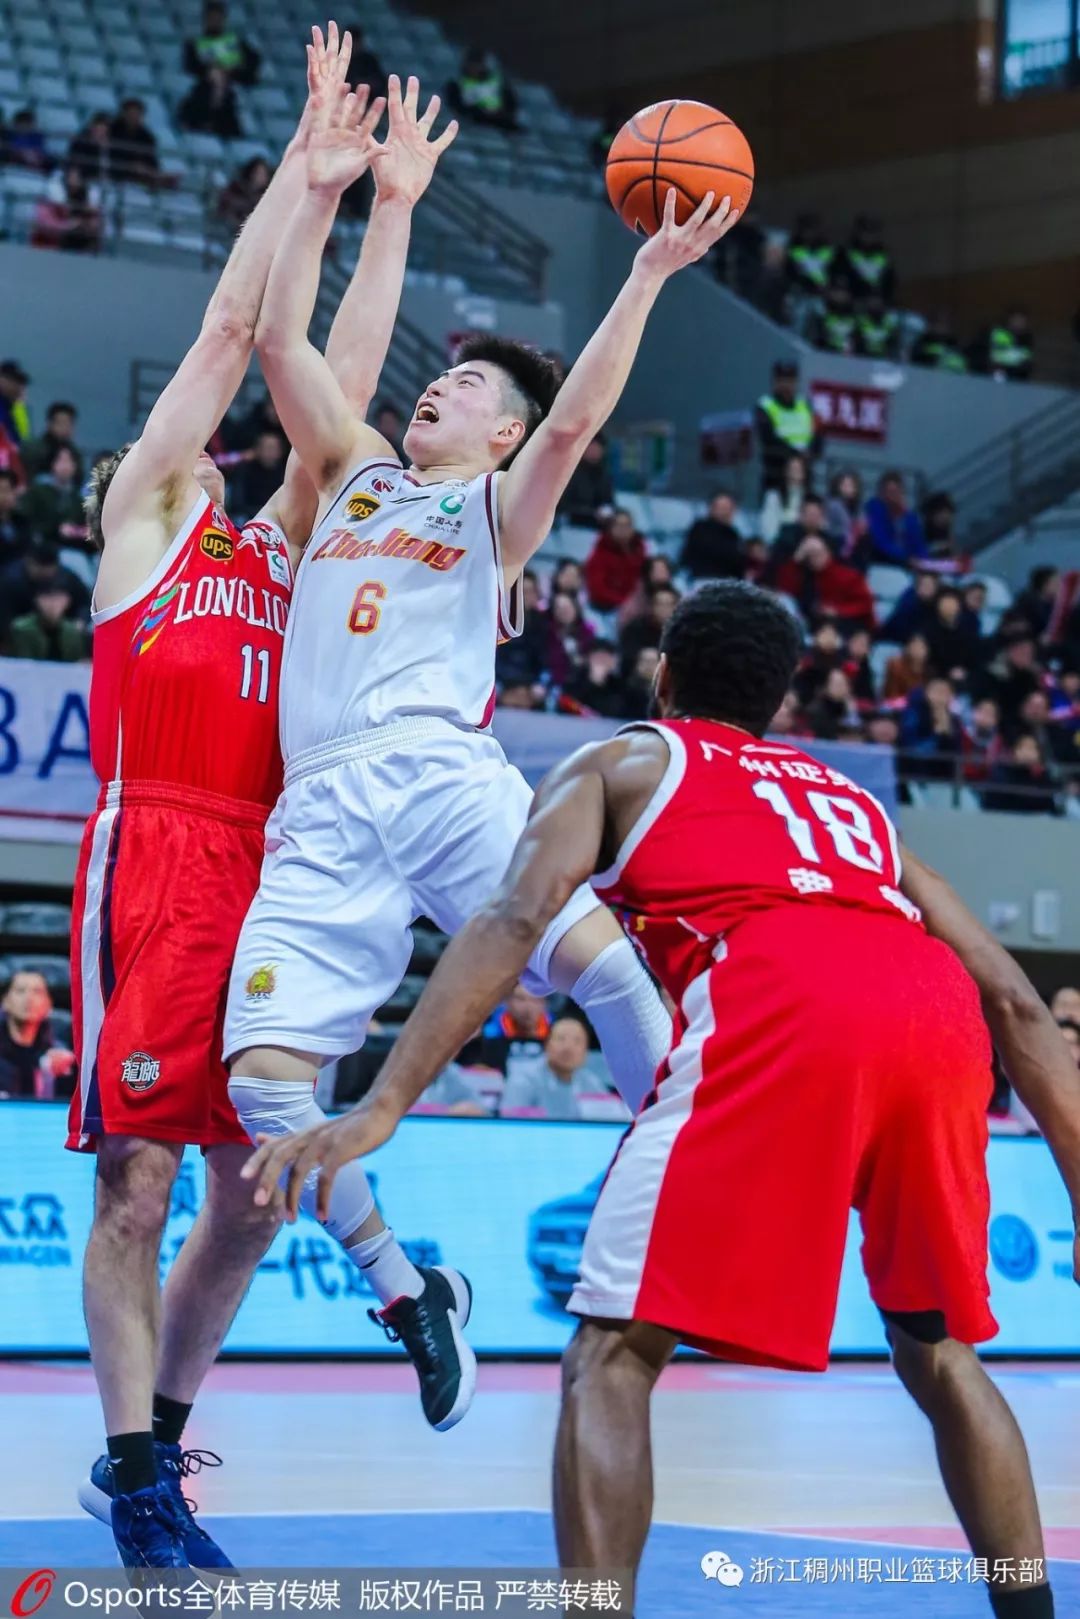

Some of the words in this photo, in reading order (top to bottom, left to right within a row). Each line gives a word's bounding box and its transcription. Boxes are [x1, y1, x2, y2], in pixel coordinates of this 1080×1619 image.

[348, 500, 375, 518] ups
[423, 522, 445, 532] CHINA
[425, 514, 464, 529] 中国人寿
[203, 536, 233, 557] ups
[347, 579, 388, 636] 6
[240, 644, 270, 704] 11
[752, 779, 883, 875] 18
